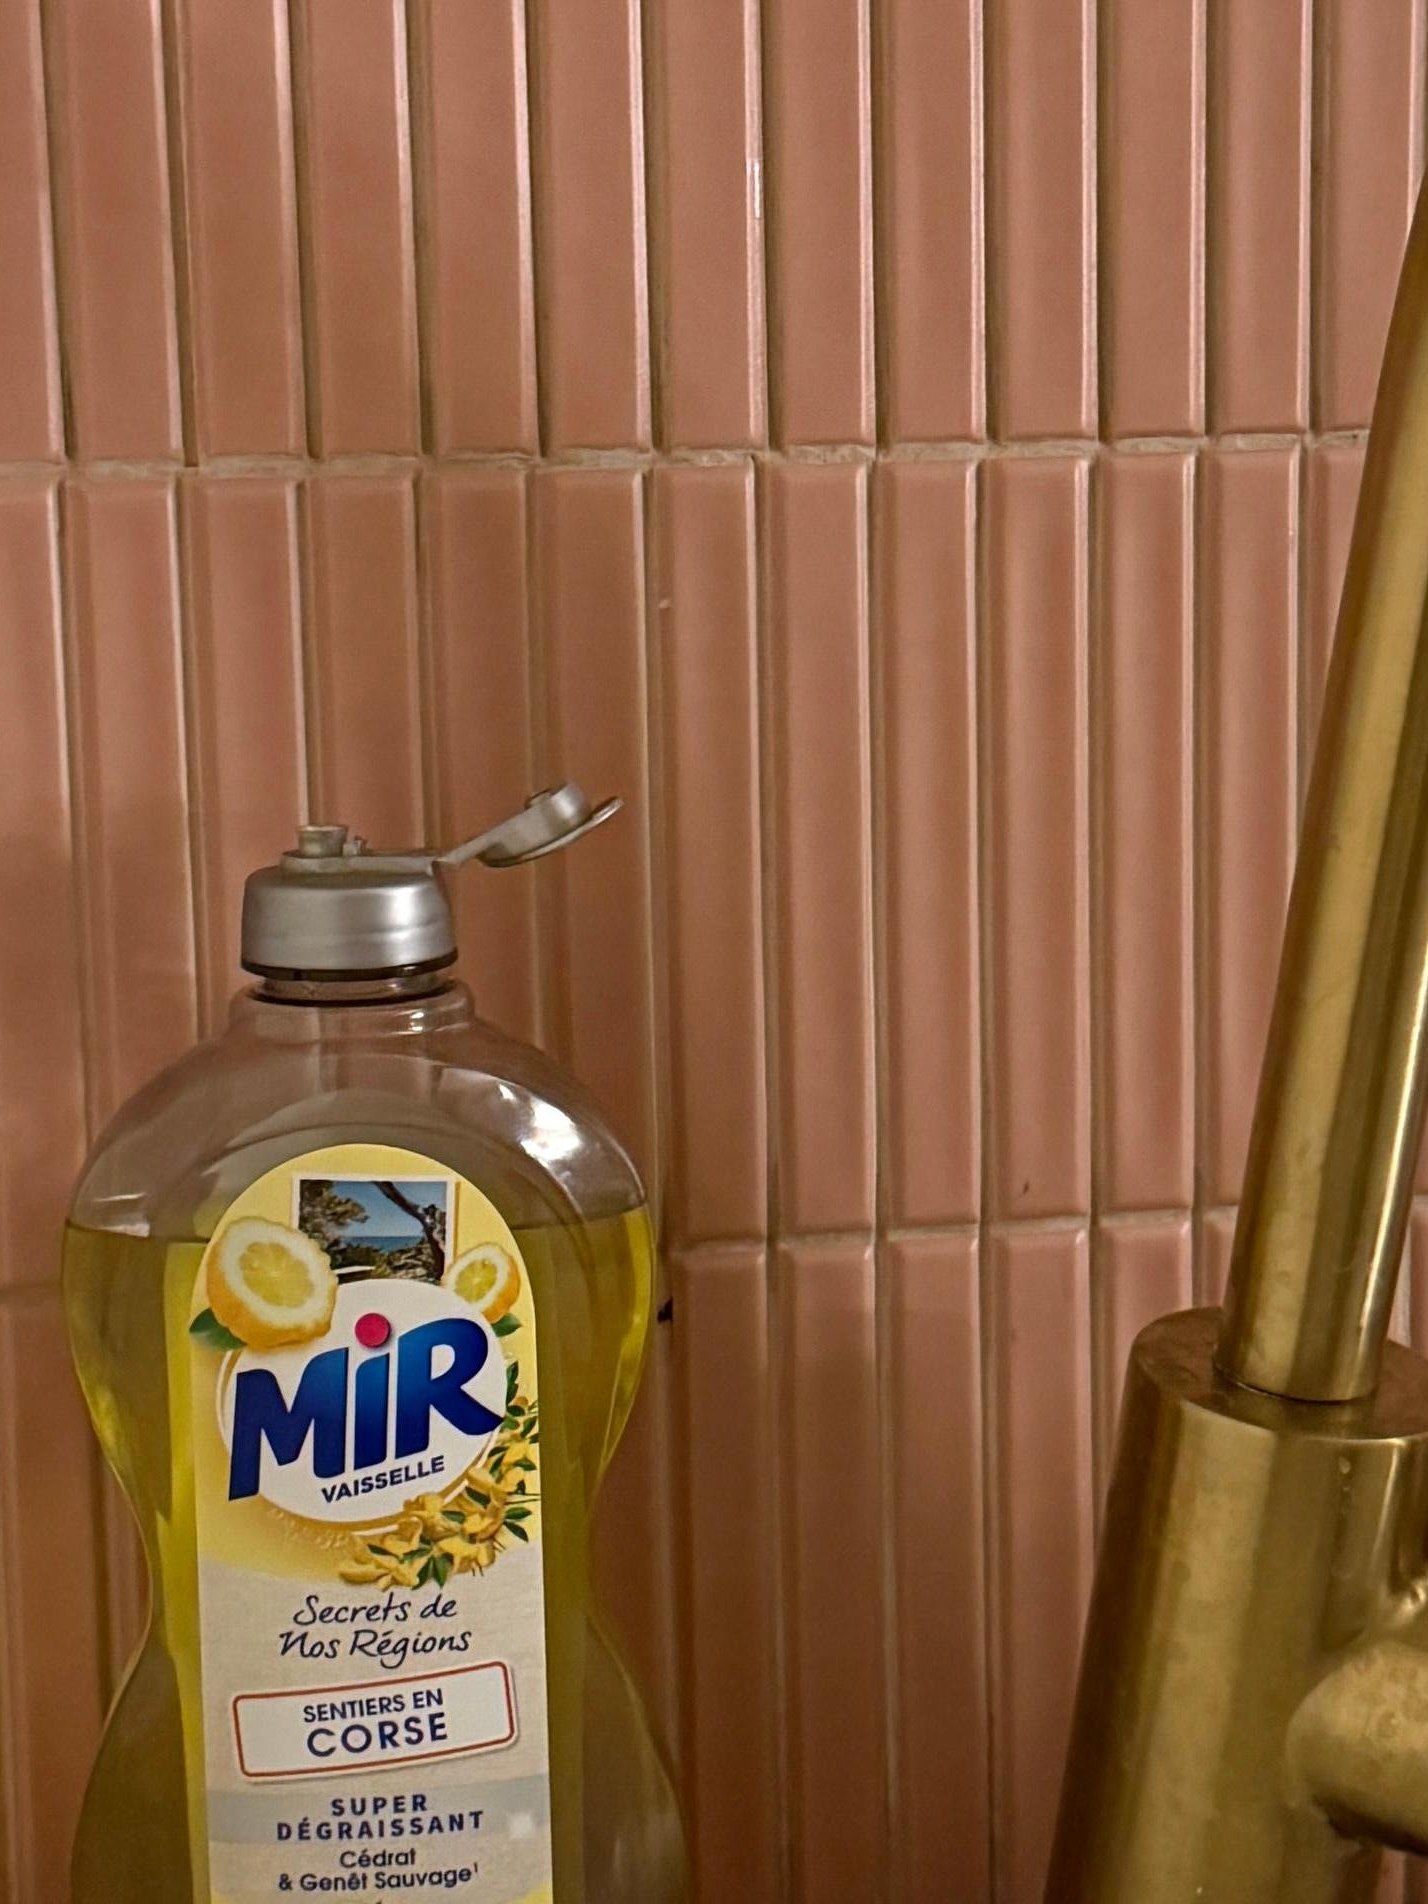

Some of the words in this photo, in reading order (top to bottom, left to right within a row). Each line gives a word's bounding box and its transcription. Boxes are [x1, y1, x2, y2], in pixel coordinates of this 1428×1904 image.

[321, 1455, 445, 1503] VAISSELLE
[293, 1592, 411, 1626] Secrets
[420, 1594, 457, 1619] de
[279, 1631, 341, 1659] Nos
[349, 1629, 472, 1669] Régions
[303, 1694, 405, 1723] SENTIERS
[412, 1688, 444, 1710] EN
[307, 1712, 448, 1758] CORSE
[331, 1794, 427, 1817] SUPER
[277, 1810, 484, 1841] DÉGRAISSANT
[339, 1847, 416, 1869] Cédrat
[278, 1873, 293, 1891] &
[300, 1872, 368, 1892] Genêt
